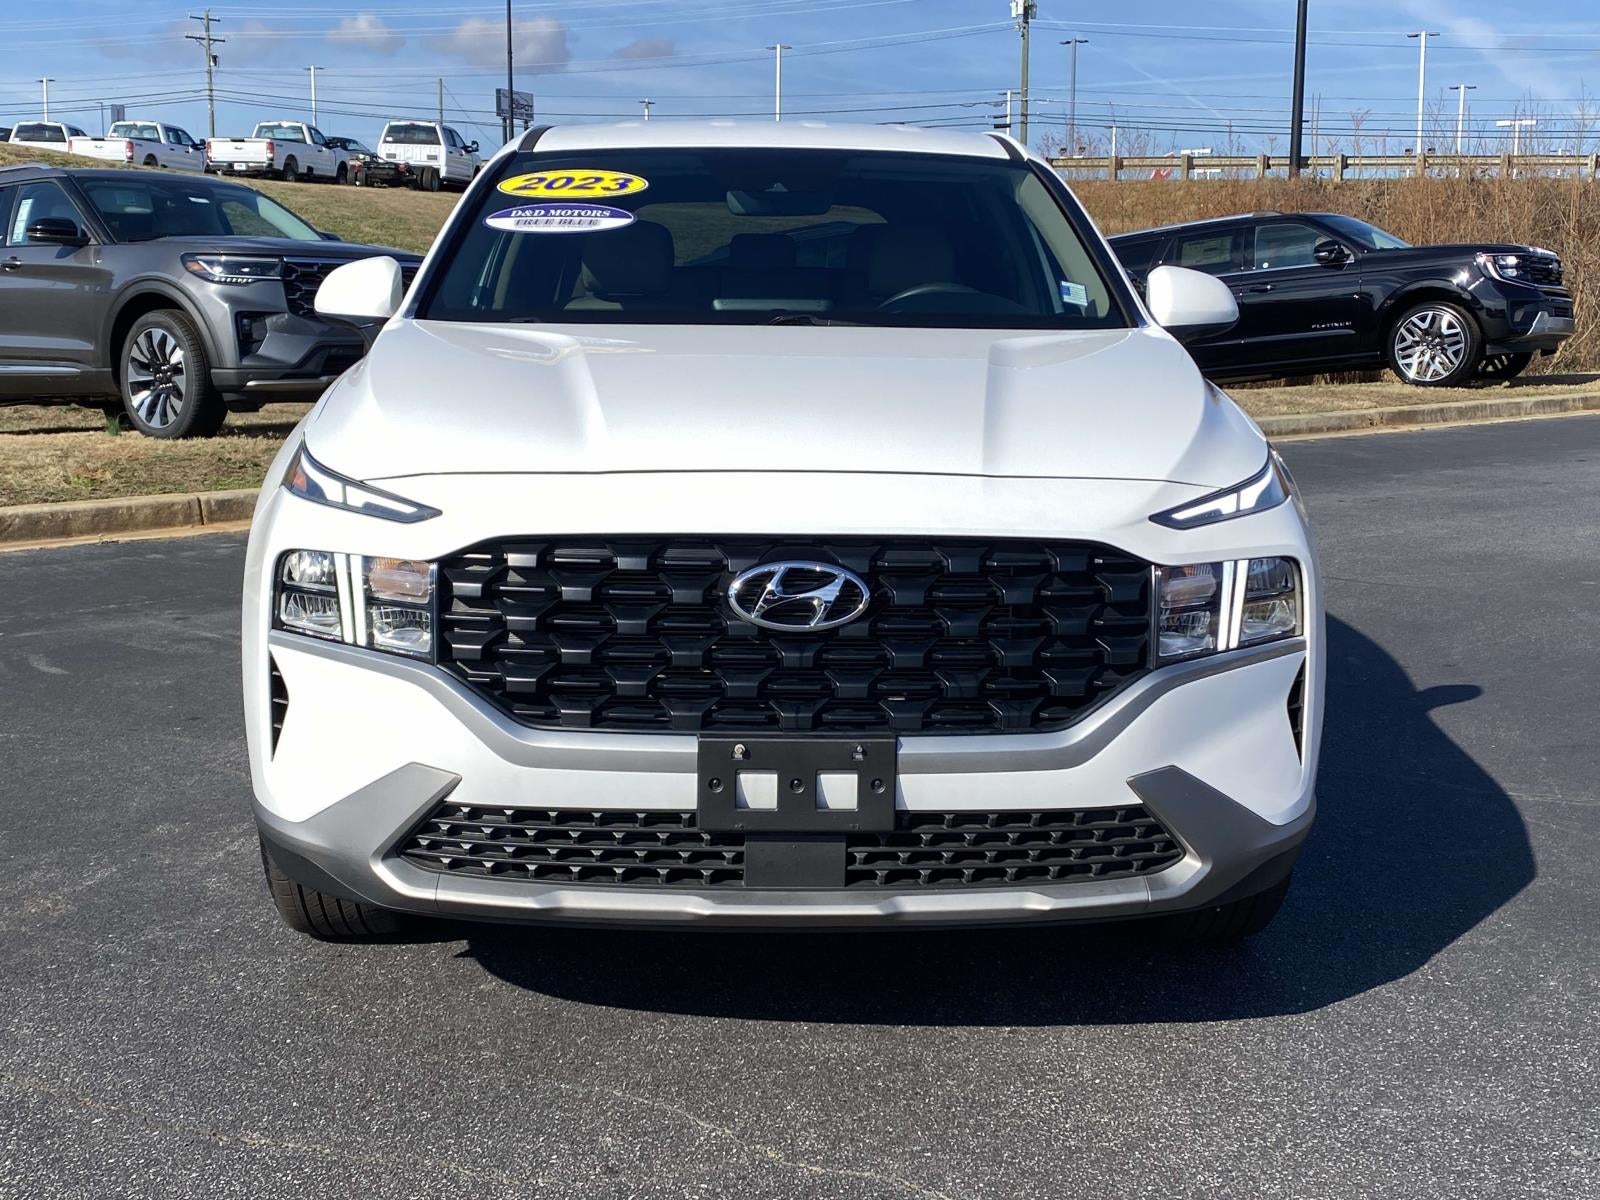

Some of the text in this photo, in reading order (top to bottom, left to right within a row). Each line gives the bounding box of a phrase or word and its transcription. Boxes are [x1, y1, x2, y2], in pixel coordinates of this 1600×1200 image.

[511, 176, 634, 191] 2023
[510, 209, 611, 217] D&D MOTORS
